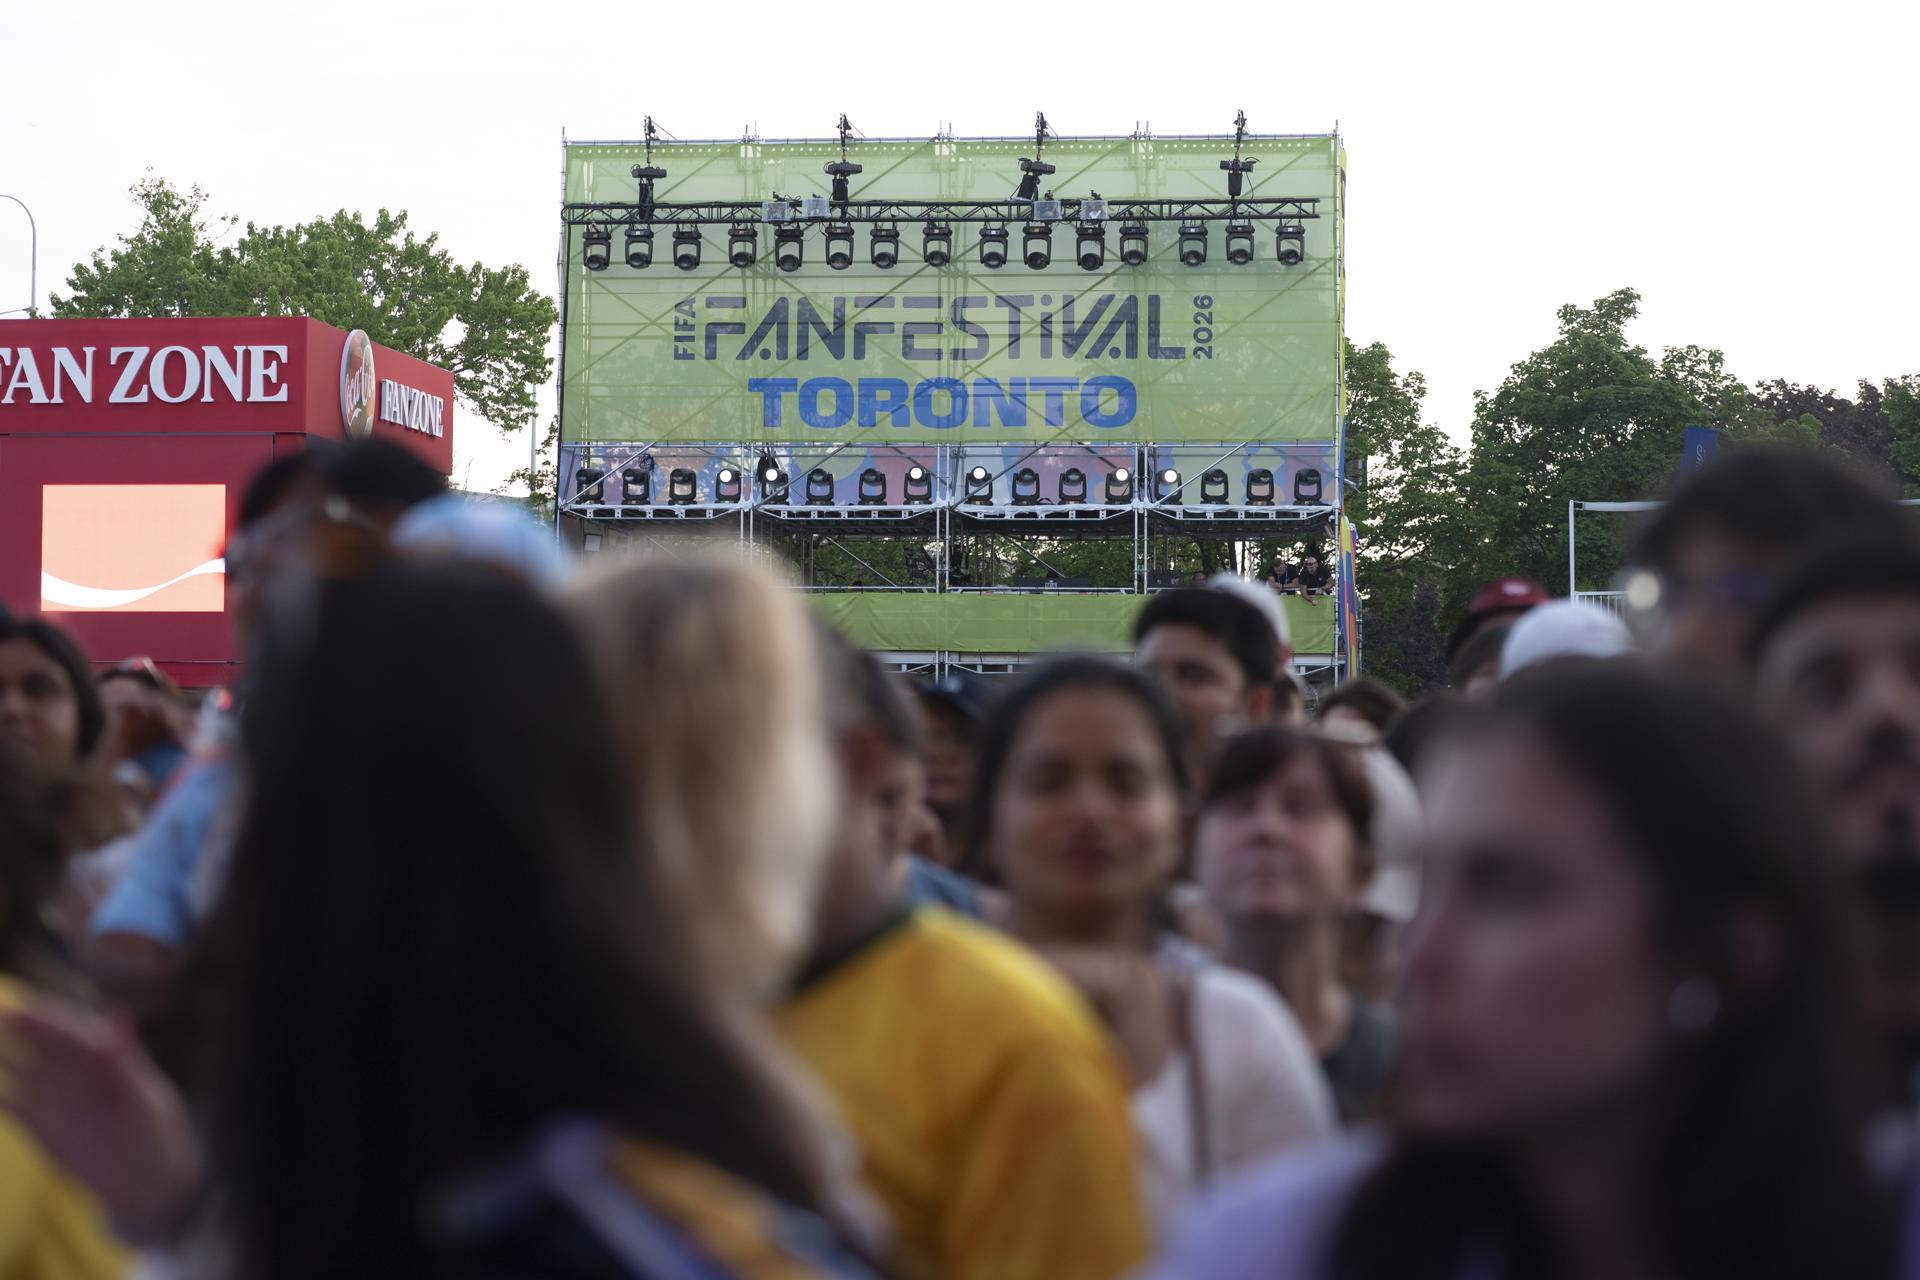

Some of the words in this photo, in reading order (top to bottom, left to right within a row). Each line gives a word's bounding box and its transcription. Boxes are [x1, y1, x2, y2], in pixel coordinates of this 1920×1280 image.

[674, 297, 696, 360] FIFA
[1193, 295, 1213, 360] 2026
[108, 345, 288, 403] ZONE
[748, 376, 1137, 429] TORONTO
[380, 379, 410, 428] FAN
[410, 387, 444, 438] ZONE
